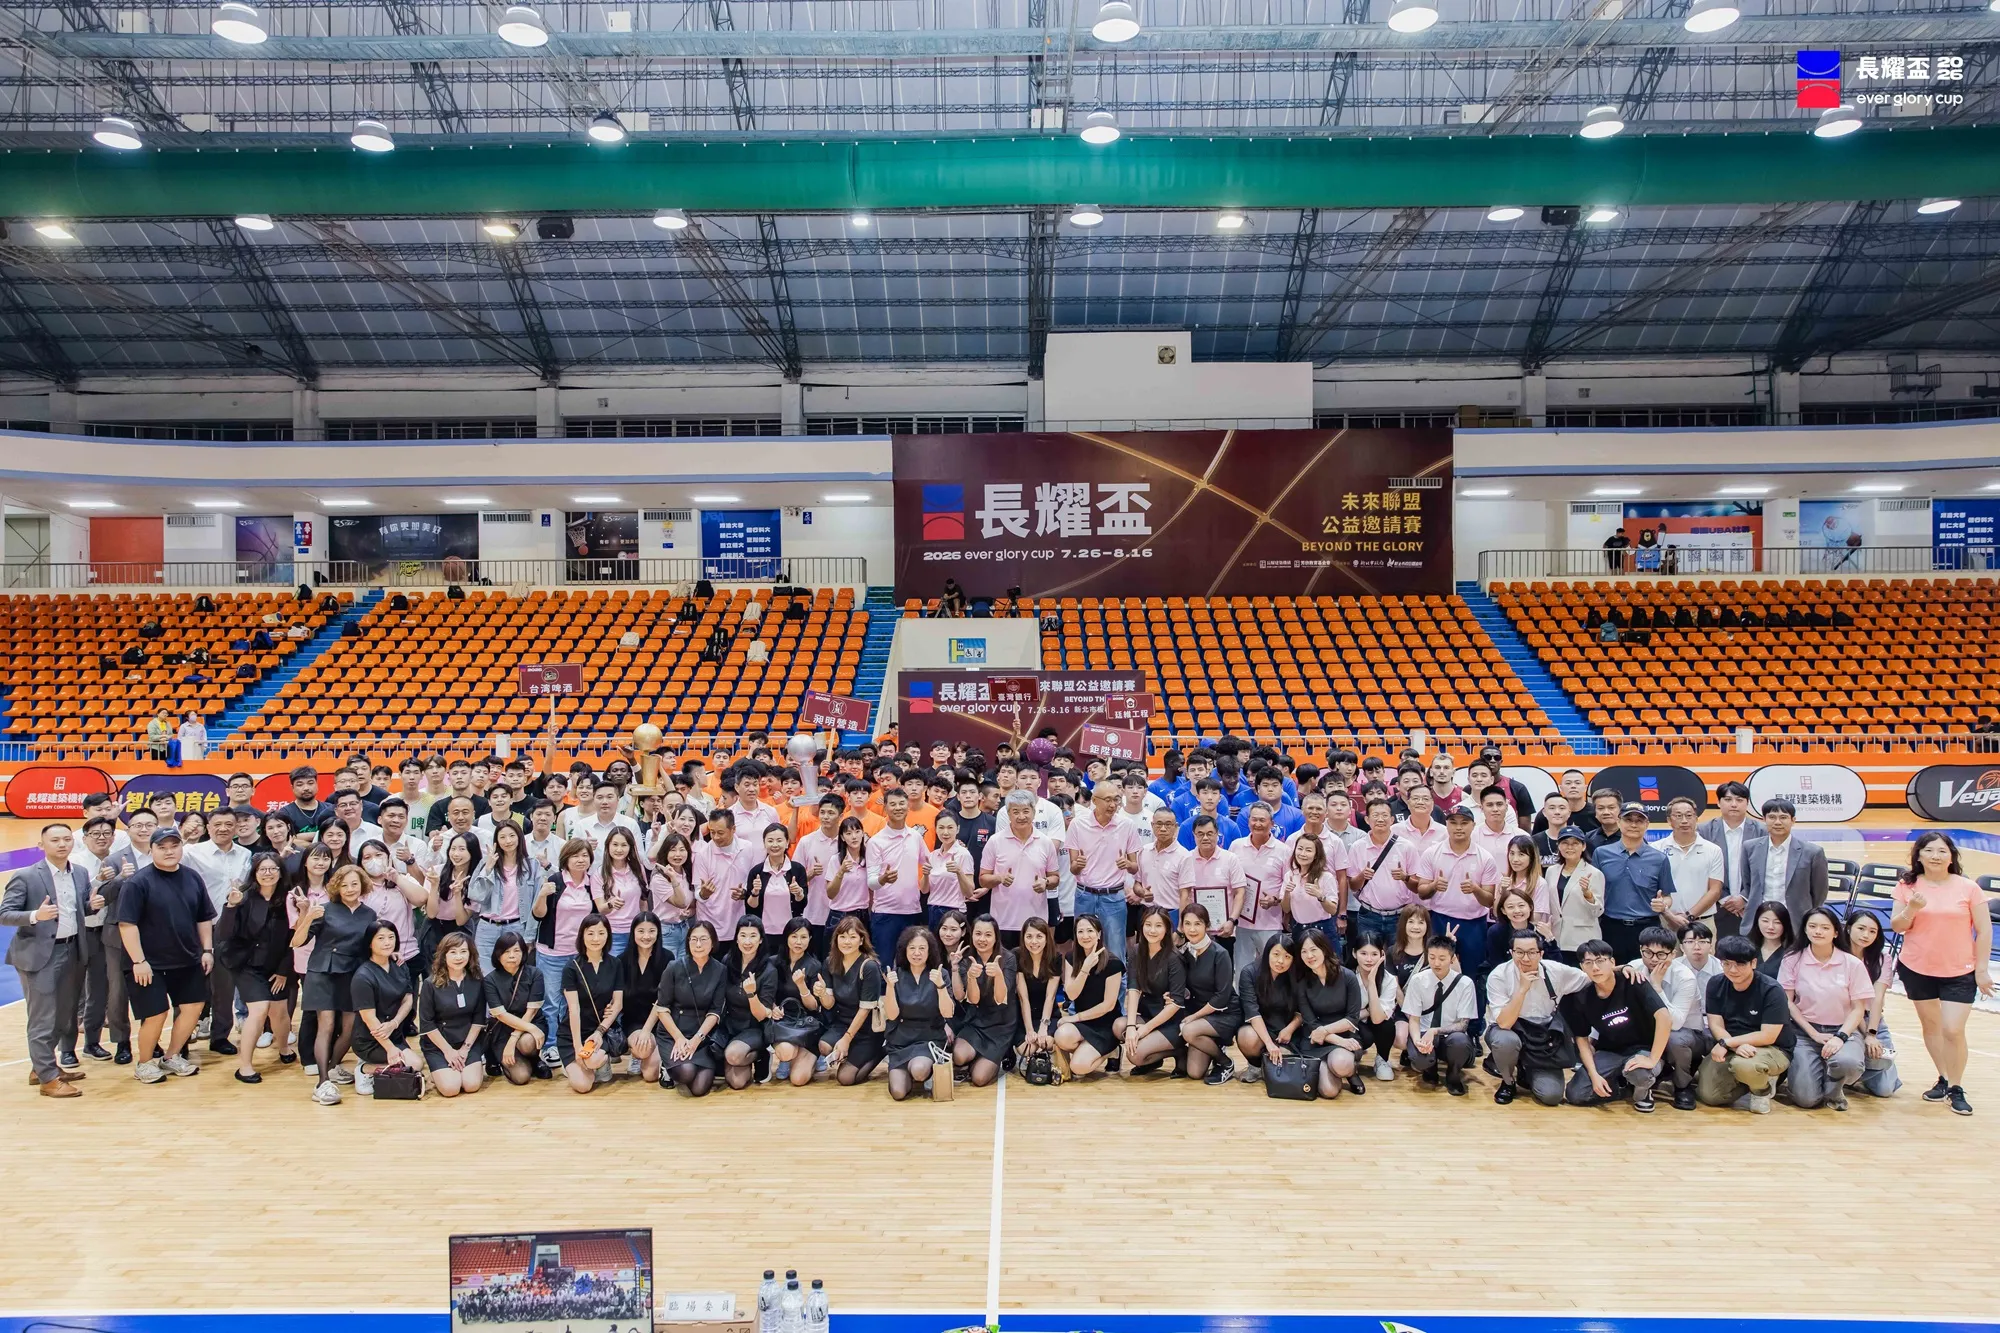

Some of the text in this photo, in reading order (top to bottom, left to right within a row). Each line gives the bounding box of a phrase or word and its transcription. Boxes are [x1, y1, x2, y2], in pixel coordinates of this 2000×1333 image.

[1341, 491, 1422, 511] 未來聯盟
[975, 482, 1152, 539] 長耀盃
[378, 521, 442, 536] 有你更加美好
[1321, 515, 1422, 534] 公益邀請賽
[1302, 541, 1424, 552] BEYOND THE GLORY
[923, 548, 1153, 562] 2026 ever glory cup 7.26-8.16
[1040, 680, 1136, 692] 來聯盟公益邀請賽
[939, 704, 966, 713] ever
[967, 702, 998, 714] glory
[1645, 804, 1660, 812] lory
